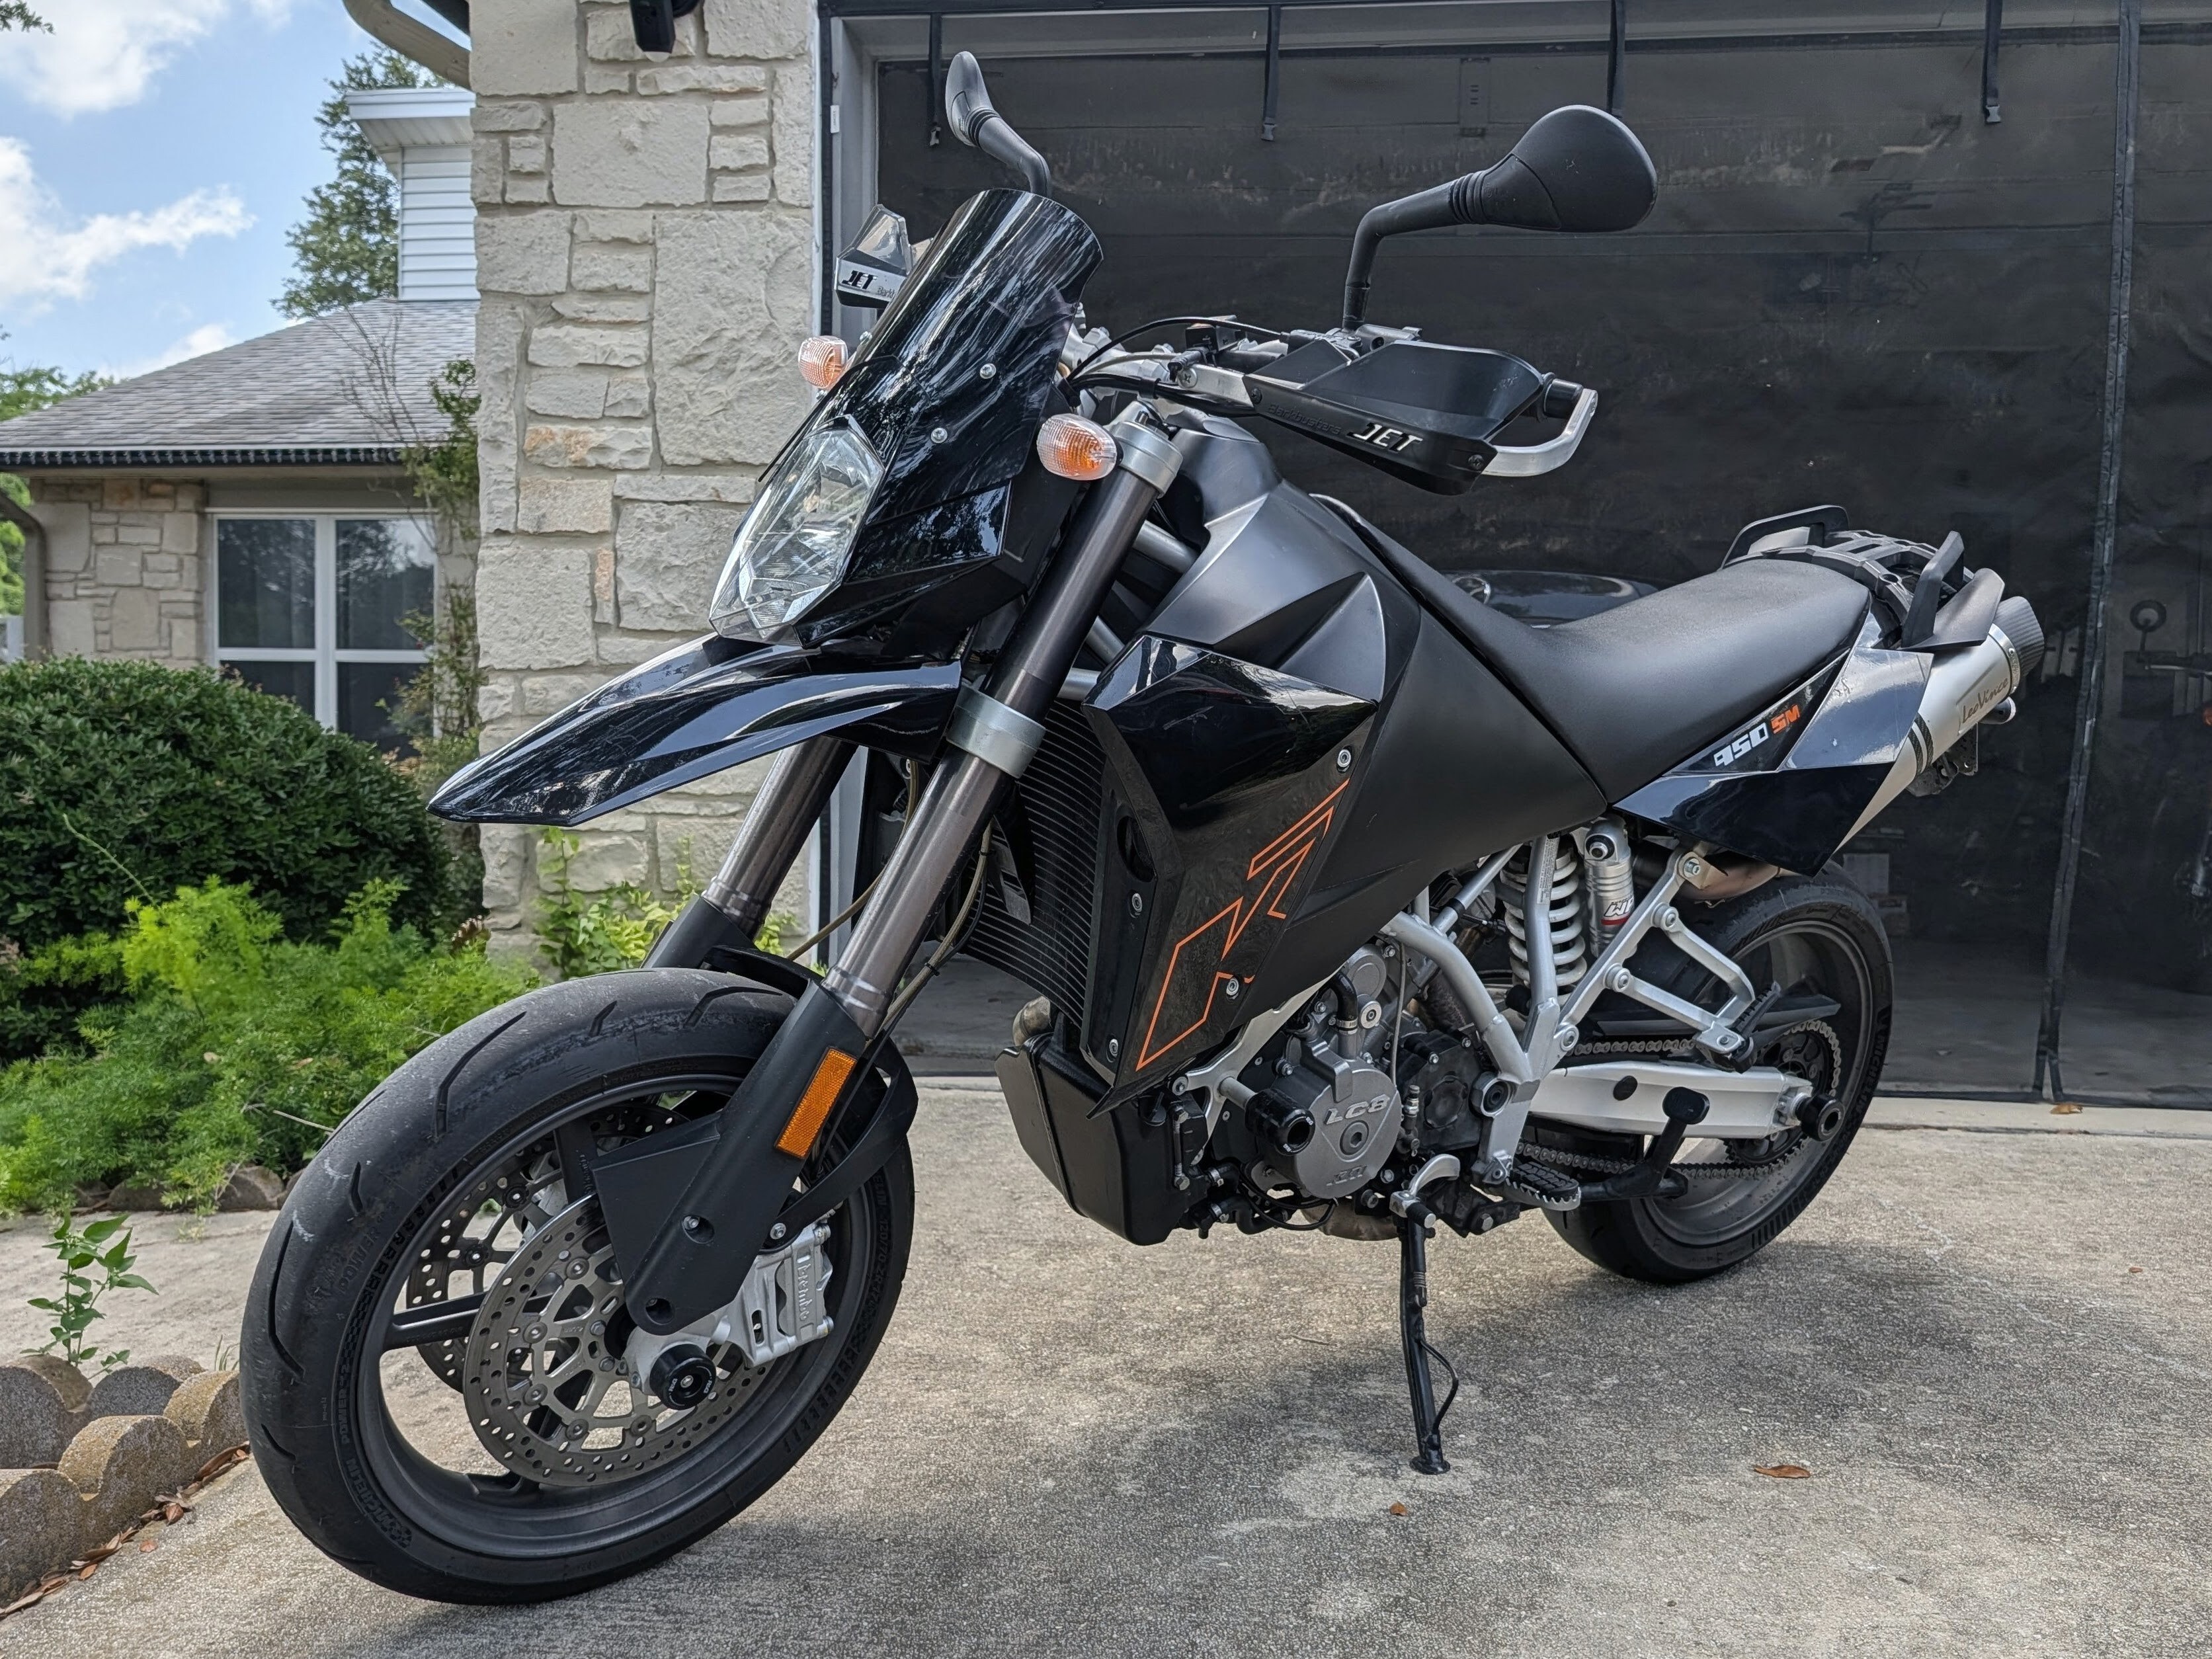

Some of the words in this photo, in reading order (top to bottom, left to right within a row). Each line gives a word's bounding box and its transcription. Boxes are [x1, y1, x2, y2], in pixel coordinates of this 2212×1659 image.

[842, 270, 878, 290] JET
[1268, 403, 1342, 435] Barkbusters
[1346, 421, 1423, 454] JET
[1713, 722, 1769, 767] 950
[1770, 704, 1801, 734] SM
[1855, 1033, 1885, 1114] MICHELIN
[1324, 1094, 1390, 1125] LC8
[337, 1389, 351, 1444] POWER
[347, 1457, 391, 1529] MICHELIN
